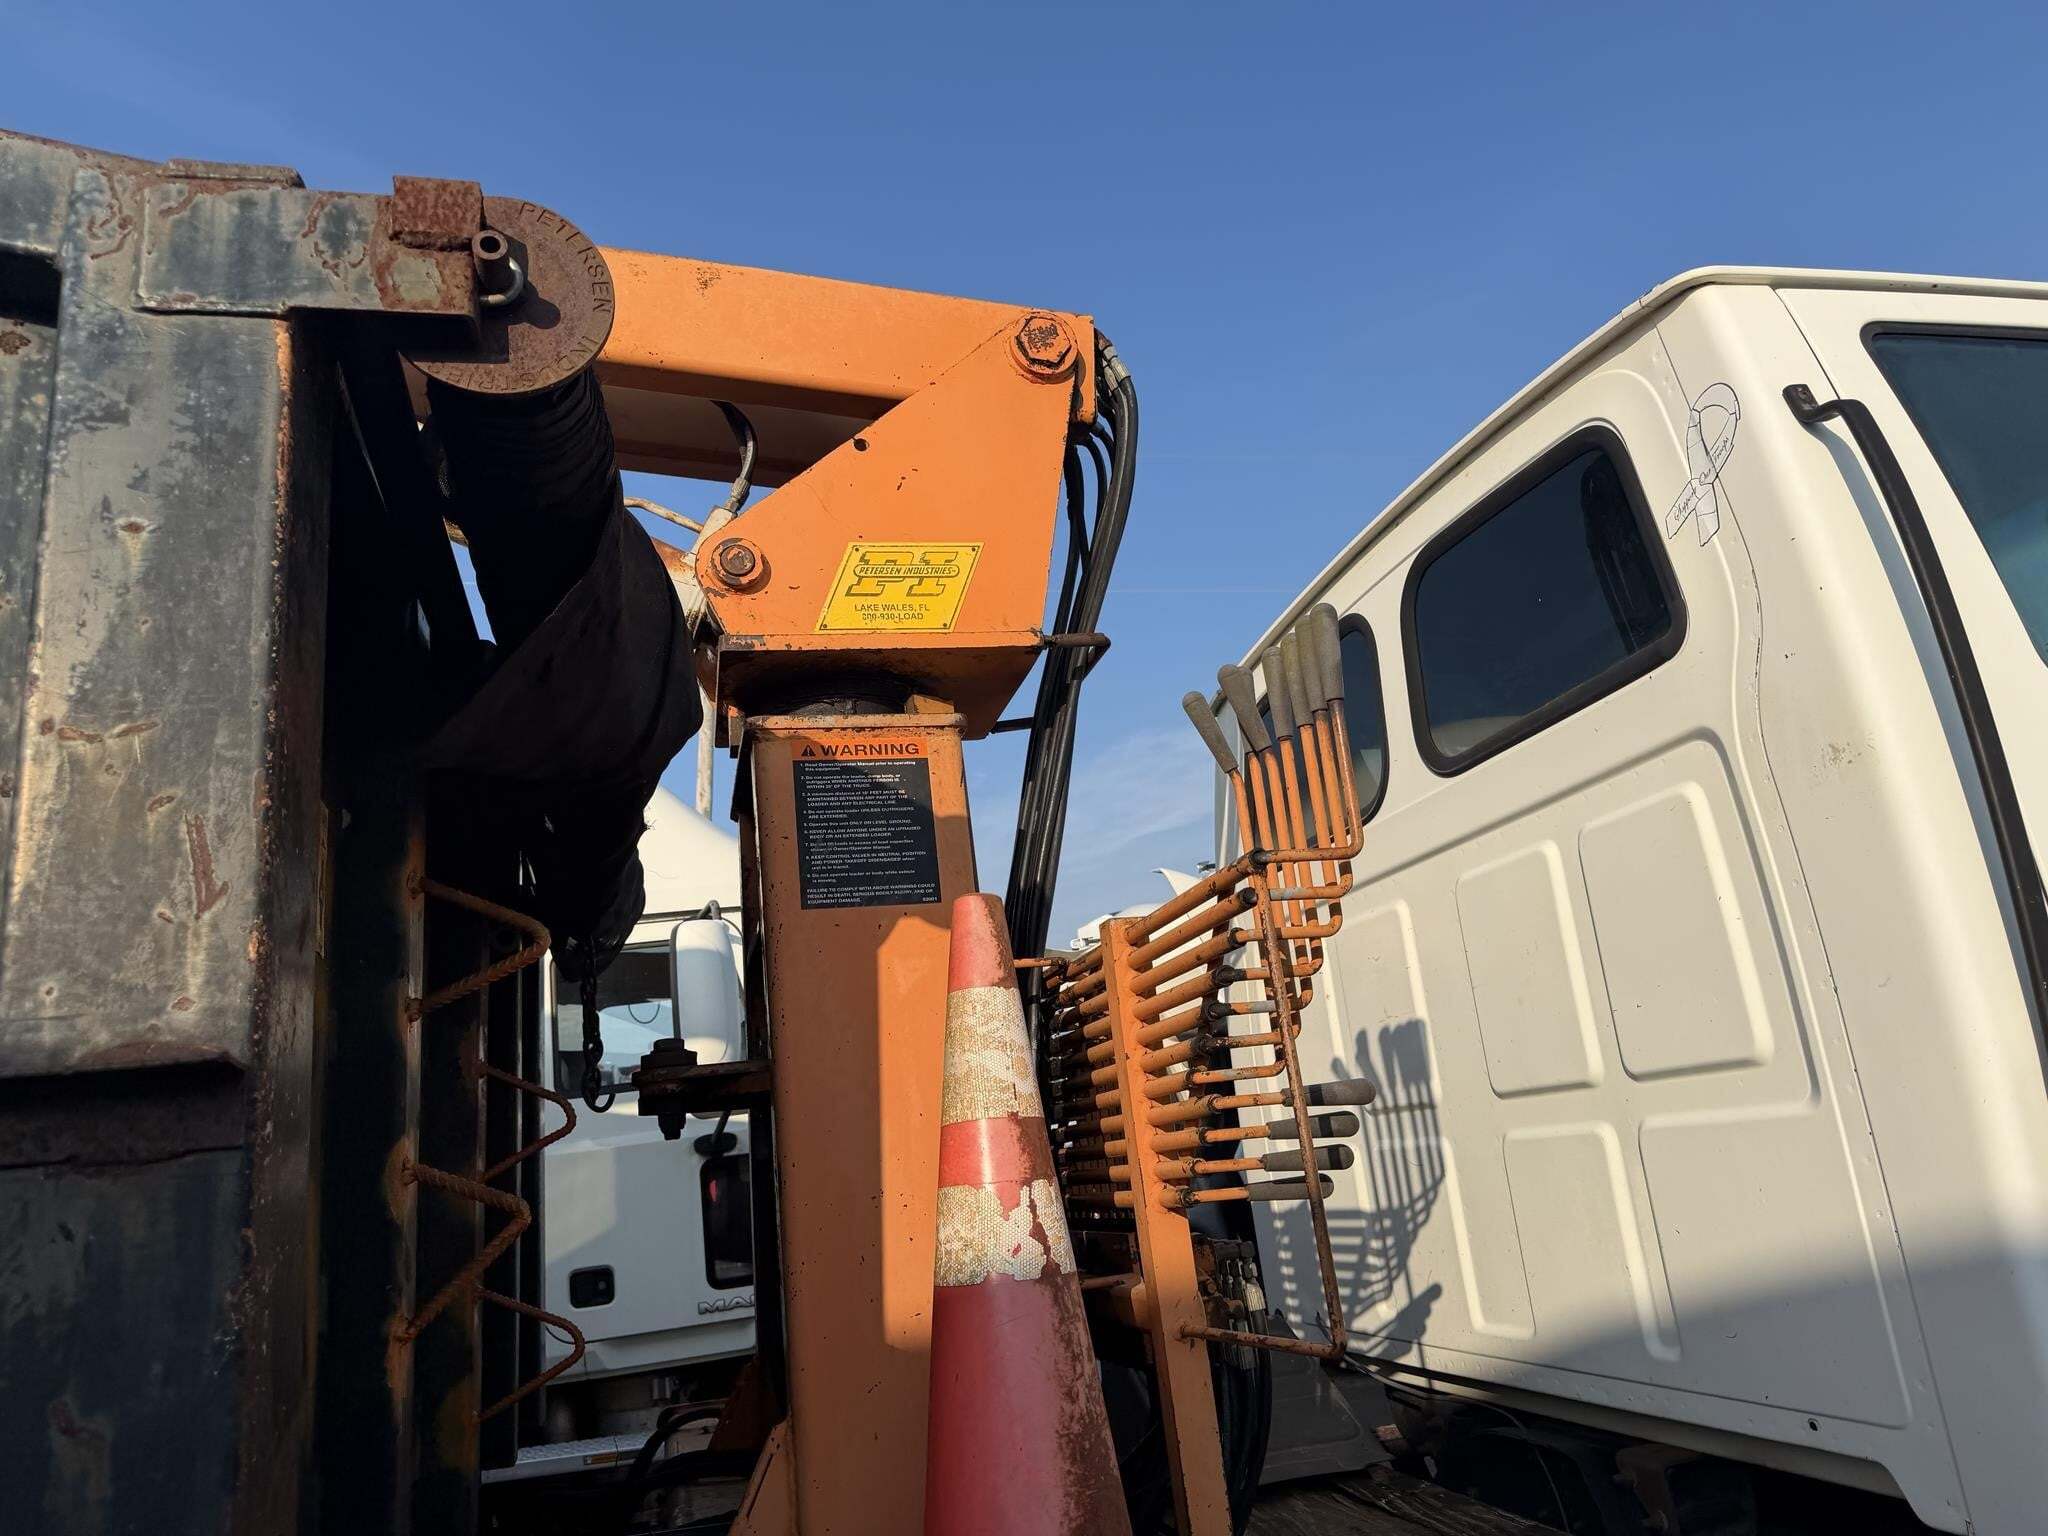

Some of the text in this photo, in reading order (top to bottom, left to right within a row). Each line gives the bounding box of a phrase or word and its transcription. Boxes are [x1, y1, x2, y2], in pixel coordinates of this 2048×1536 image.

[518, 201, 612, 314] PETERSEN
[858, 566, 952, 576] PETERSEN INDUSTRIES
[854, 603, 930, 613] LAKE WALES, FL
[819, 743, 920, 757] WARNING
[697, 1295, 755, 1315] MA
